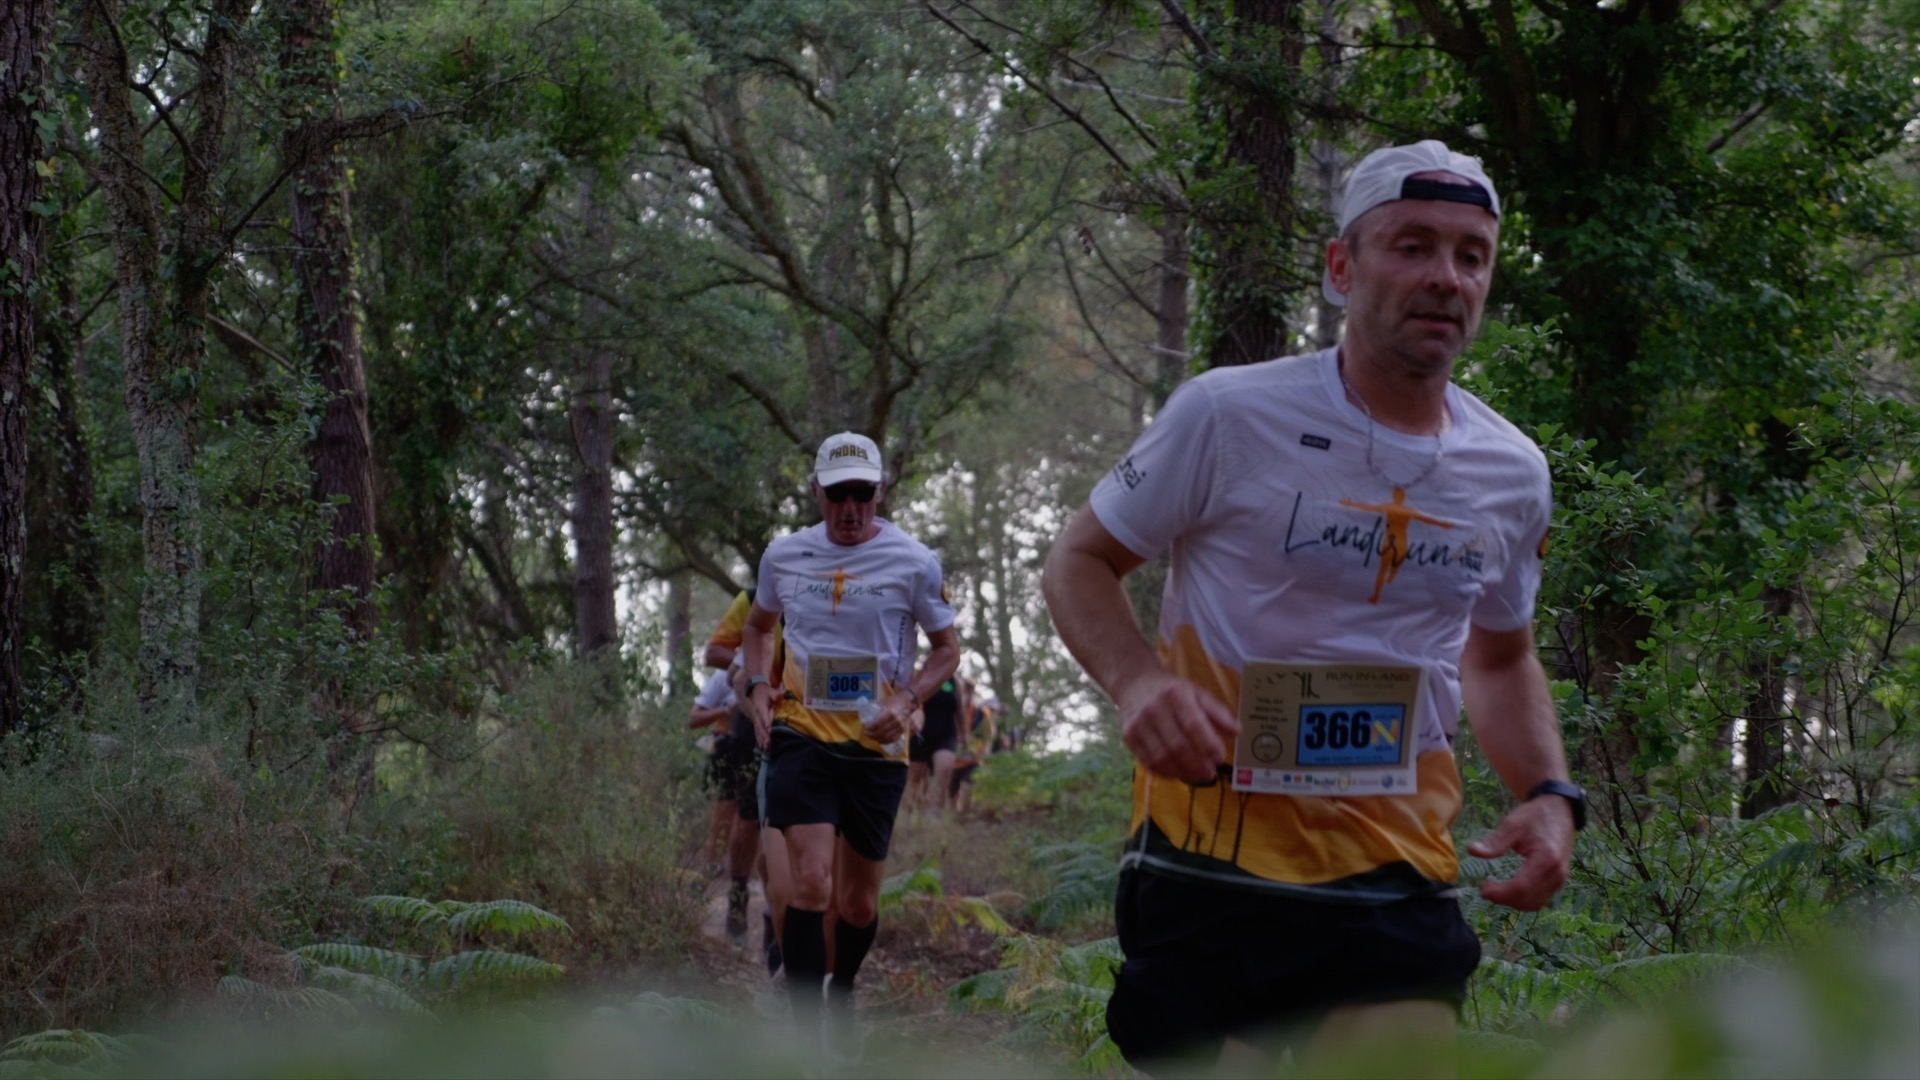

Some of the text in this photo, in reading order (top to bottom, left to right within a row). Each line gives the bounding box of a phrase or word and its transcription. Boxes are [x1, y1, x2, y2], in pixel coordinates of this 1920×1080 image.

[829, 444, 868, 461] PADRES
[829, 675, 860, 693] 308
[1326, 671, 1411, 682] RUN IN LAND
[1304, 710, 1372, 750] 366
